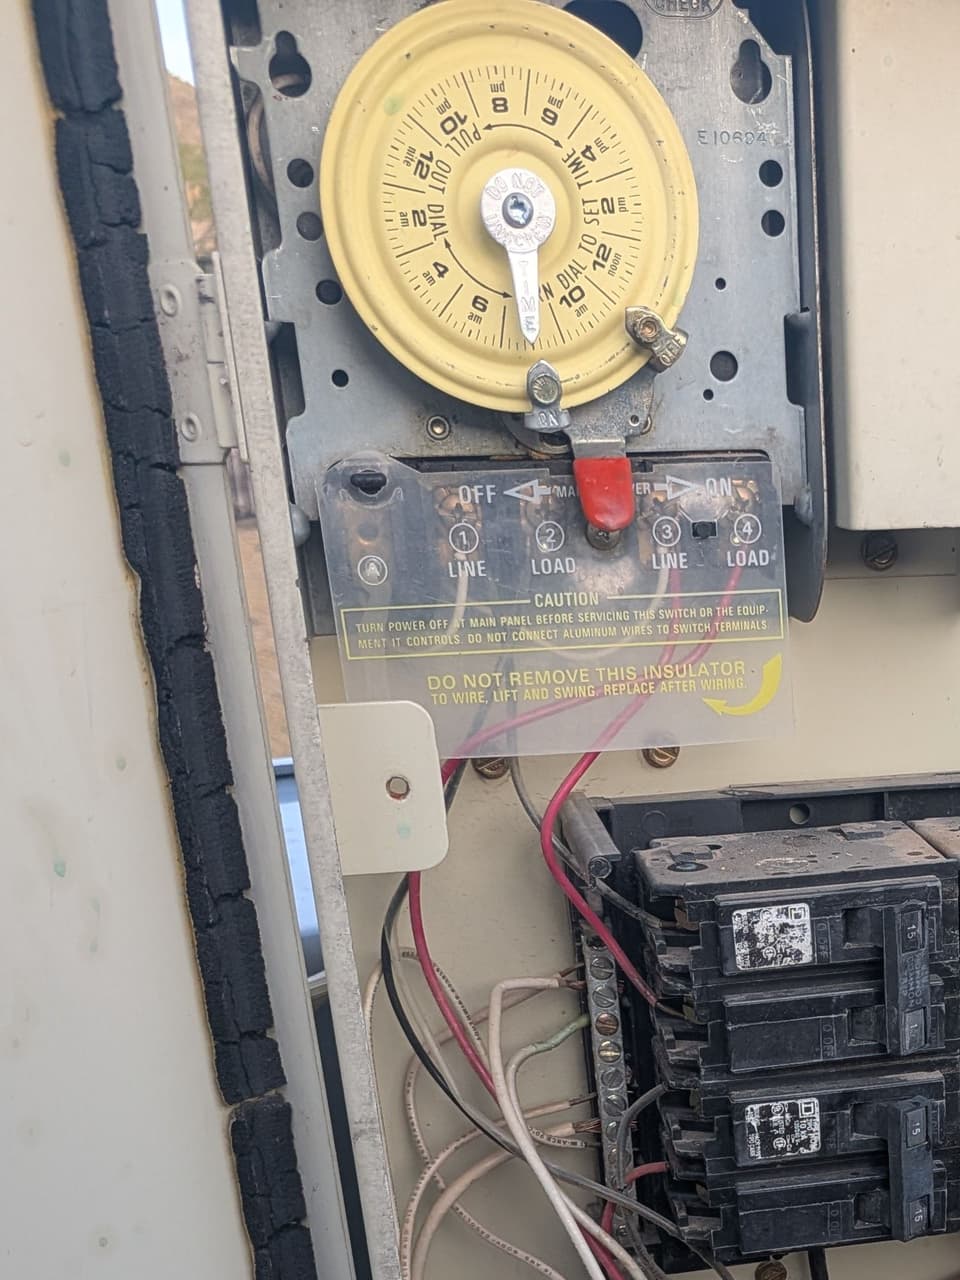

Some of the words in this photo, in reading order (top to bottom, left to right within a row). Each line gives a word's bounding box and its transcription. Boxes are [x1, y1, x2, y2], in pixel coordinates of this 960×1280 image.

[490, 80, 506, 93] pm
[436, 97, 452, 116] pm
[491, 97, 508, 113] 8
[547, 95, 564, 109] pm
[440, 111, 468, 135] 10
[540, 107, 558, 126] 6
[444, 122, 482, 157] PULL
[594, 136, 610, 154] pm
[402, 146, 416, 167] nite
[580, 144, 597, 162] 4
[413, 150, 434, 180] 12
[562, 148, 593, 190] TIME
[428, 159, 452, 194] OUT
[582, 198, 600, 226] SET
[600, 196, 615, 215] 2
[618, 196, 629, 213] pm
[400, 212, 410, 228] am
[412, 209, 428, 228] 2
[427, 204, 449, 241] DIAL
[577, 233, 598, 254] TO
[592, 243, 613, 272] 12
[608, 252, 622, 277] noon
[422, 270, 436, 286] am
[432, 261, 450, 278] 4
[556, 258, 588, 290] DIAL
[472, 295, 489, 313] 6
[560, 284, 586, 308] 10
[467, 312, 483, 325] am
[574, 303, 588, 318] am
[458, 484, 497, 504] OFF
[706, 476, 732, 497] ON
[531, 558, 576, 576] LOAD
[652, 552, 688, 570] LINE
[726, 550, 770, 568] LOAD
[448, 560, 487, 578] LINE
[534, 591, 600, 608] CAUTION
[356, 622, 384, 634] TURN
[388, 620, 426, 632] POWER
[429, 619, 449, 630] OFF
[454, 618, 466, 629] AT
[469, 617, 497, 629] MAIN
[500, 615, 532, 627] PANEL
[536, 612, 574, 626] BEFORE
[578, 610, 630, 623] SERVICING
[634, 609, 656, 620] THIS
[658, 607, 698, 620] SWITCH
[700, 606, 714, 618] OR
[716, 606, 734, 617] THE
[358, 638, 388, 650] MENT
[392, 637, 402, 648] IT
[467, 634, 483, 644] DO
[486, 632, 508, 643] NOT
[512, 628, 559, 642] CONNECT
[563, 626, 617, 639] ALUMINUM
[621, 624, 654, 636] WIRES
[656, 624, 670, 634] TO
[673, 622, 712, 634] SWITCH
[427, 674, 456, 690] DO
[463, 672, 504, 688] NOT
[509, 668, 590, 686] REMOVE
[596, 666, 638, 682] THIS
[643, 660, 746, 680] INSULATOR
[430, 693, 448, 705] TO
[452, 692, 489, 705] WIRE,
[492, 690, 519, 702] LIFT
[523, 688, 550, 700] AND
[554, 684, 598, 699] SWING.
[604, 681, 656, 696] REPLACE
[660, 680, 697, 694] AFTER
[700, 677, 747, 691] WIRING.
[912, 1122, 921, 1136] 15
[914, 1208, 924, 1222] 15
